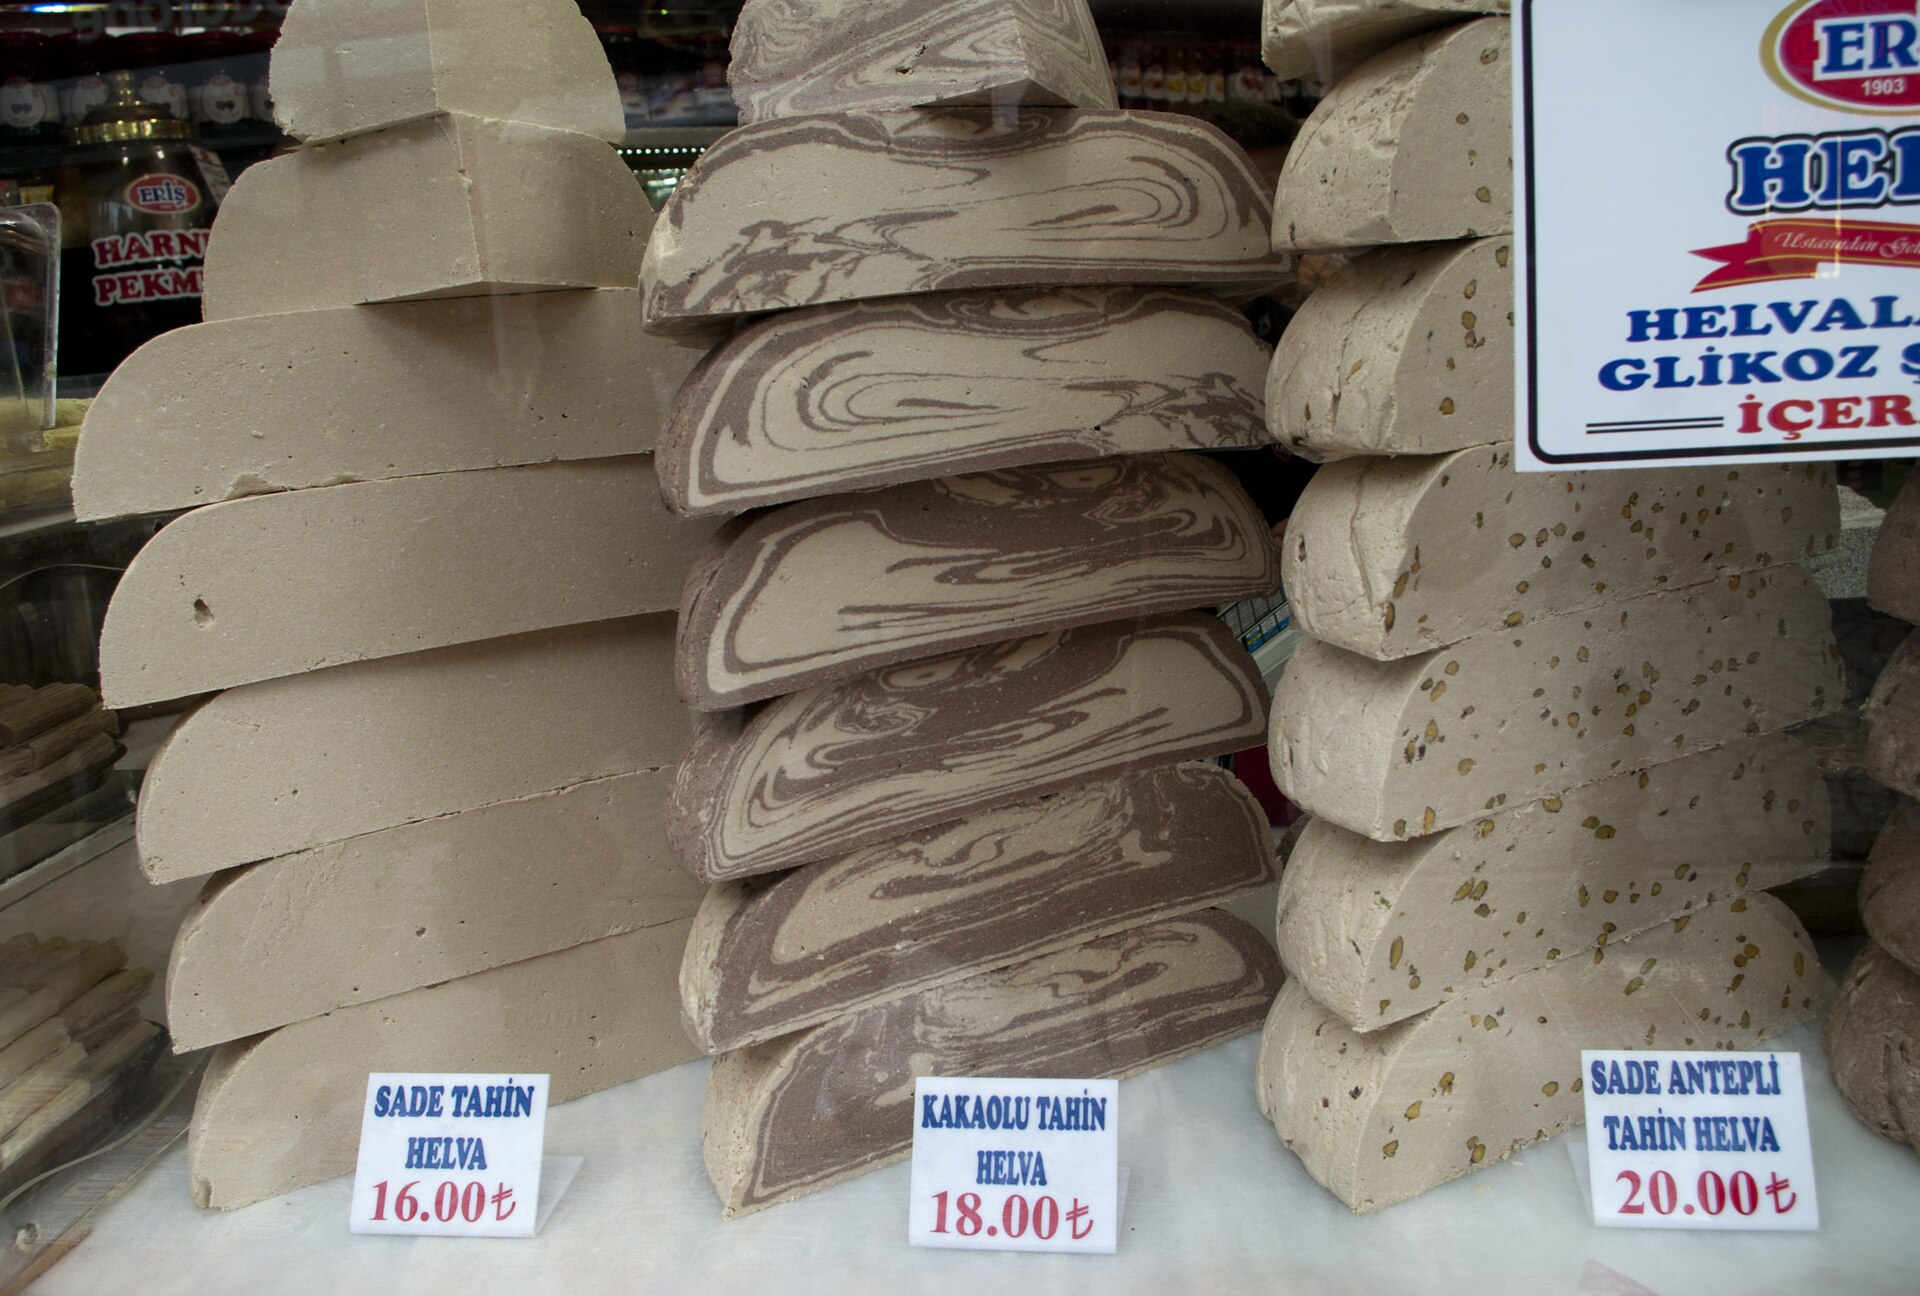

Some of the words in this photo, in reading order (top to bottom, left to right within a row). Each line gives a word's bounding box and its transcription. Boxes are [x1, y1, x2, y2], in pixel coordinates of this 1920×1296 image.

[1861, 77, 1905, 97] 1903
[138, 180, 187, 207] ERİŞ
[92, 229, 210, 269] HARN
[92, 266, 204, 307] PEKM
[1625, 294, 1920, 342] HELVAL
[1597, 345, 1880, 391] GLİKOZ
[1736, 393, 1920, 440] İÇER
[1590, 1059, 1661, 1095] SADE
[1667, 1053, 1781, 1096] ANTEPLİ
[373, 1084, 444, 1118] SADE
[450, 1077, 535, 1118] TAHİN
[921, 1094, 1031, 1131] KAKAOLU
[1036, 1088, 1107, 1132] TAHİN
[1602, 1107, 1687, 1152] TAHİN
[1692, 1116, 1781, 1153] HELVA
[404, 1136, 488, 1171] HELVA
[975, 1150, 1048, 1186] HELVA
